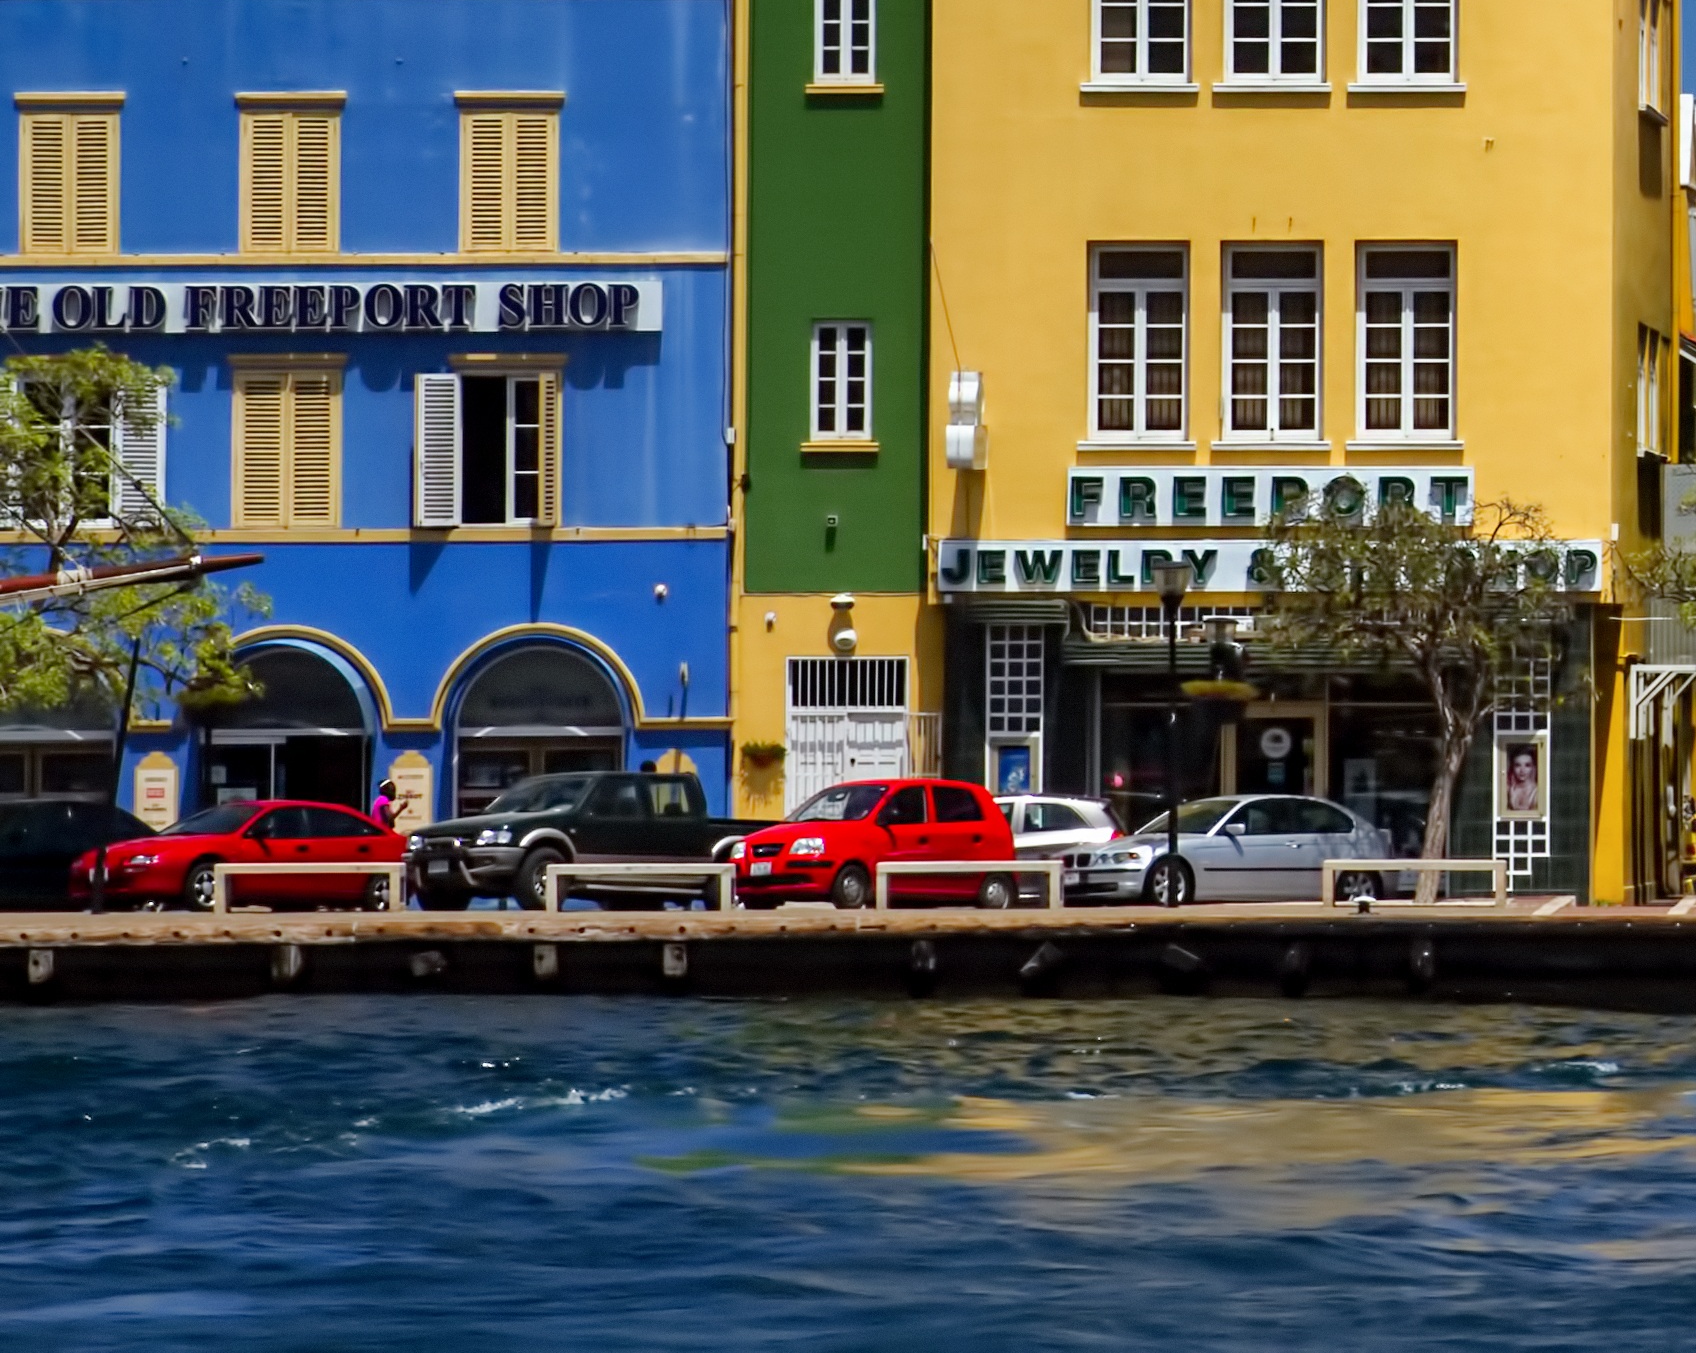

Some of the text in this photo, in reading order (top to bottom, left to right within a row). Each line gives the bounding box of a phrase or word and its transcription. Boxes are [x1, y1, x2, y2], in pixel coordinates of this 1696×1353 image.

[52, 285, 167, 330] OLD
[184, 284, 477, 330] FREEPORT
[498, 283, 640, 329] SHOP
